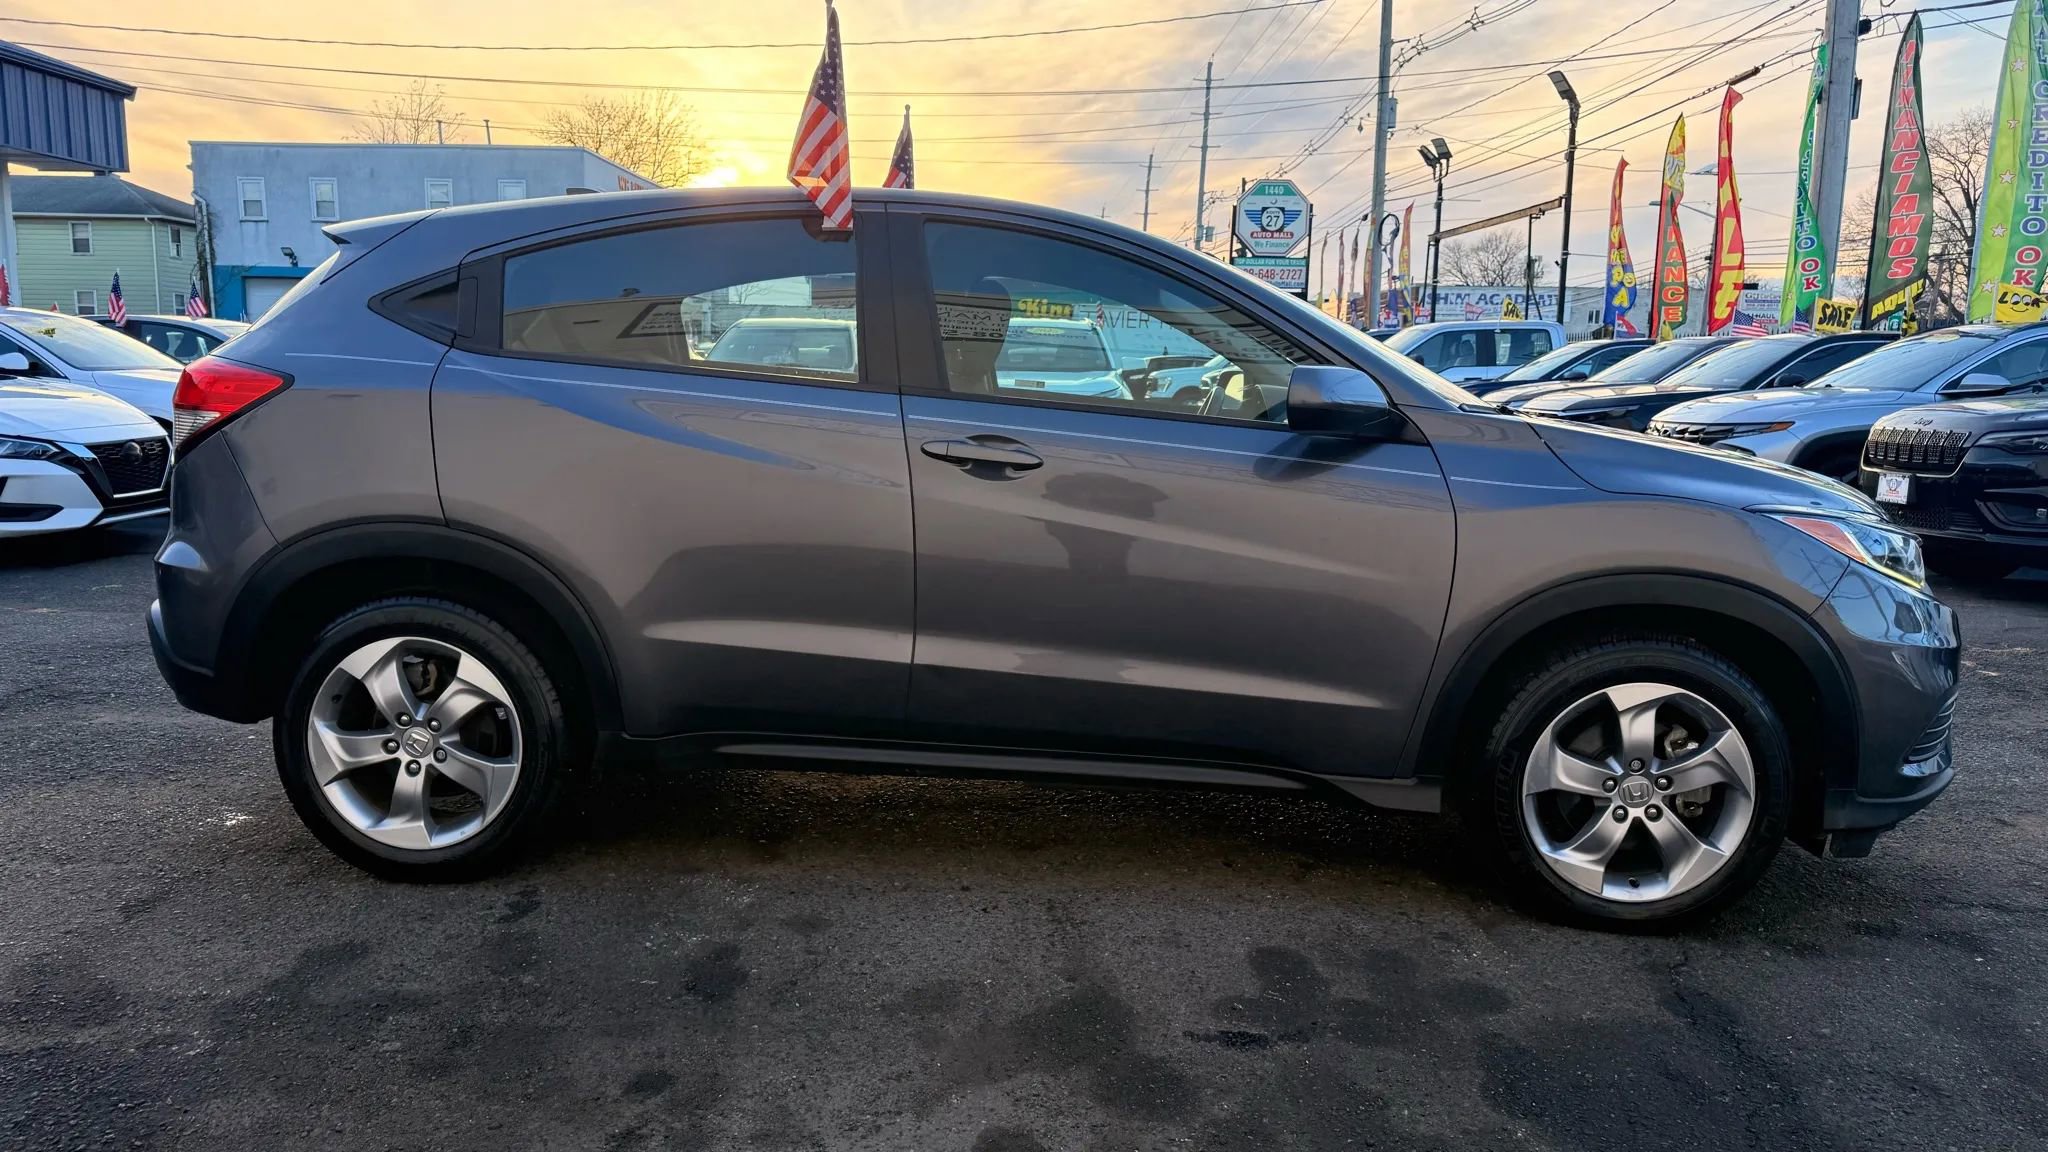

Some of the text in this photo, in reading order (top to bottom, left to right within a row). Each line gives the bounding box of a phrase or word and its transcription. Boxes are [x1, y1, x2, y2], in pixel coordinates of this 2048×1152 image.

[1887, 39, 1923, 280] FINANCIAMOS
[1265, 186, 1284, 194] 1440
[1265, 215, 1280, 227] 27
[1243, 268, 1302, 280] 8-648-2727
[1662, 226, 1685, 322] NANCE
[1800, 257, 1821, 291] OK
[2013, 246, 2042, 286] OK
[1818, 300, 1855, 328] SALE
